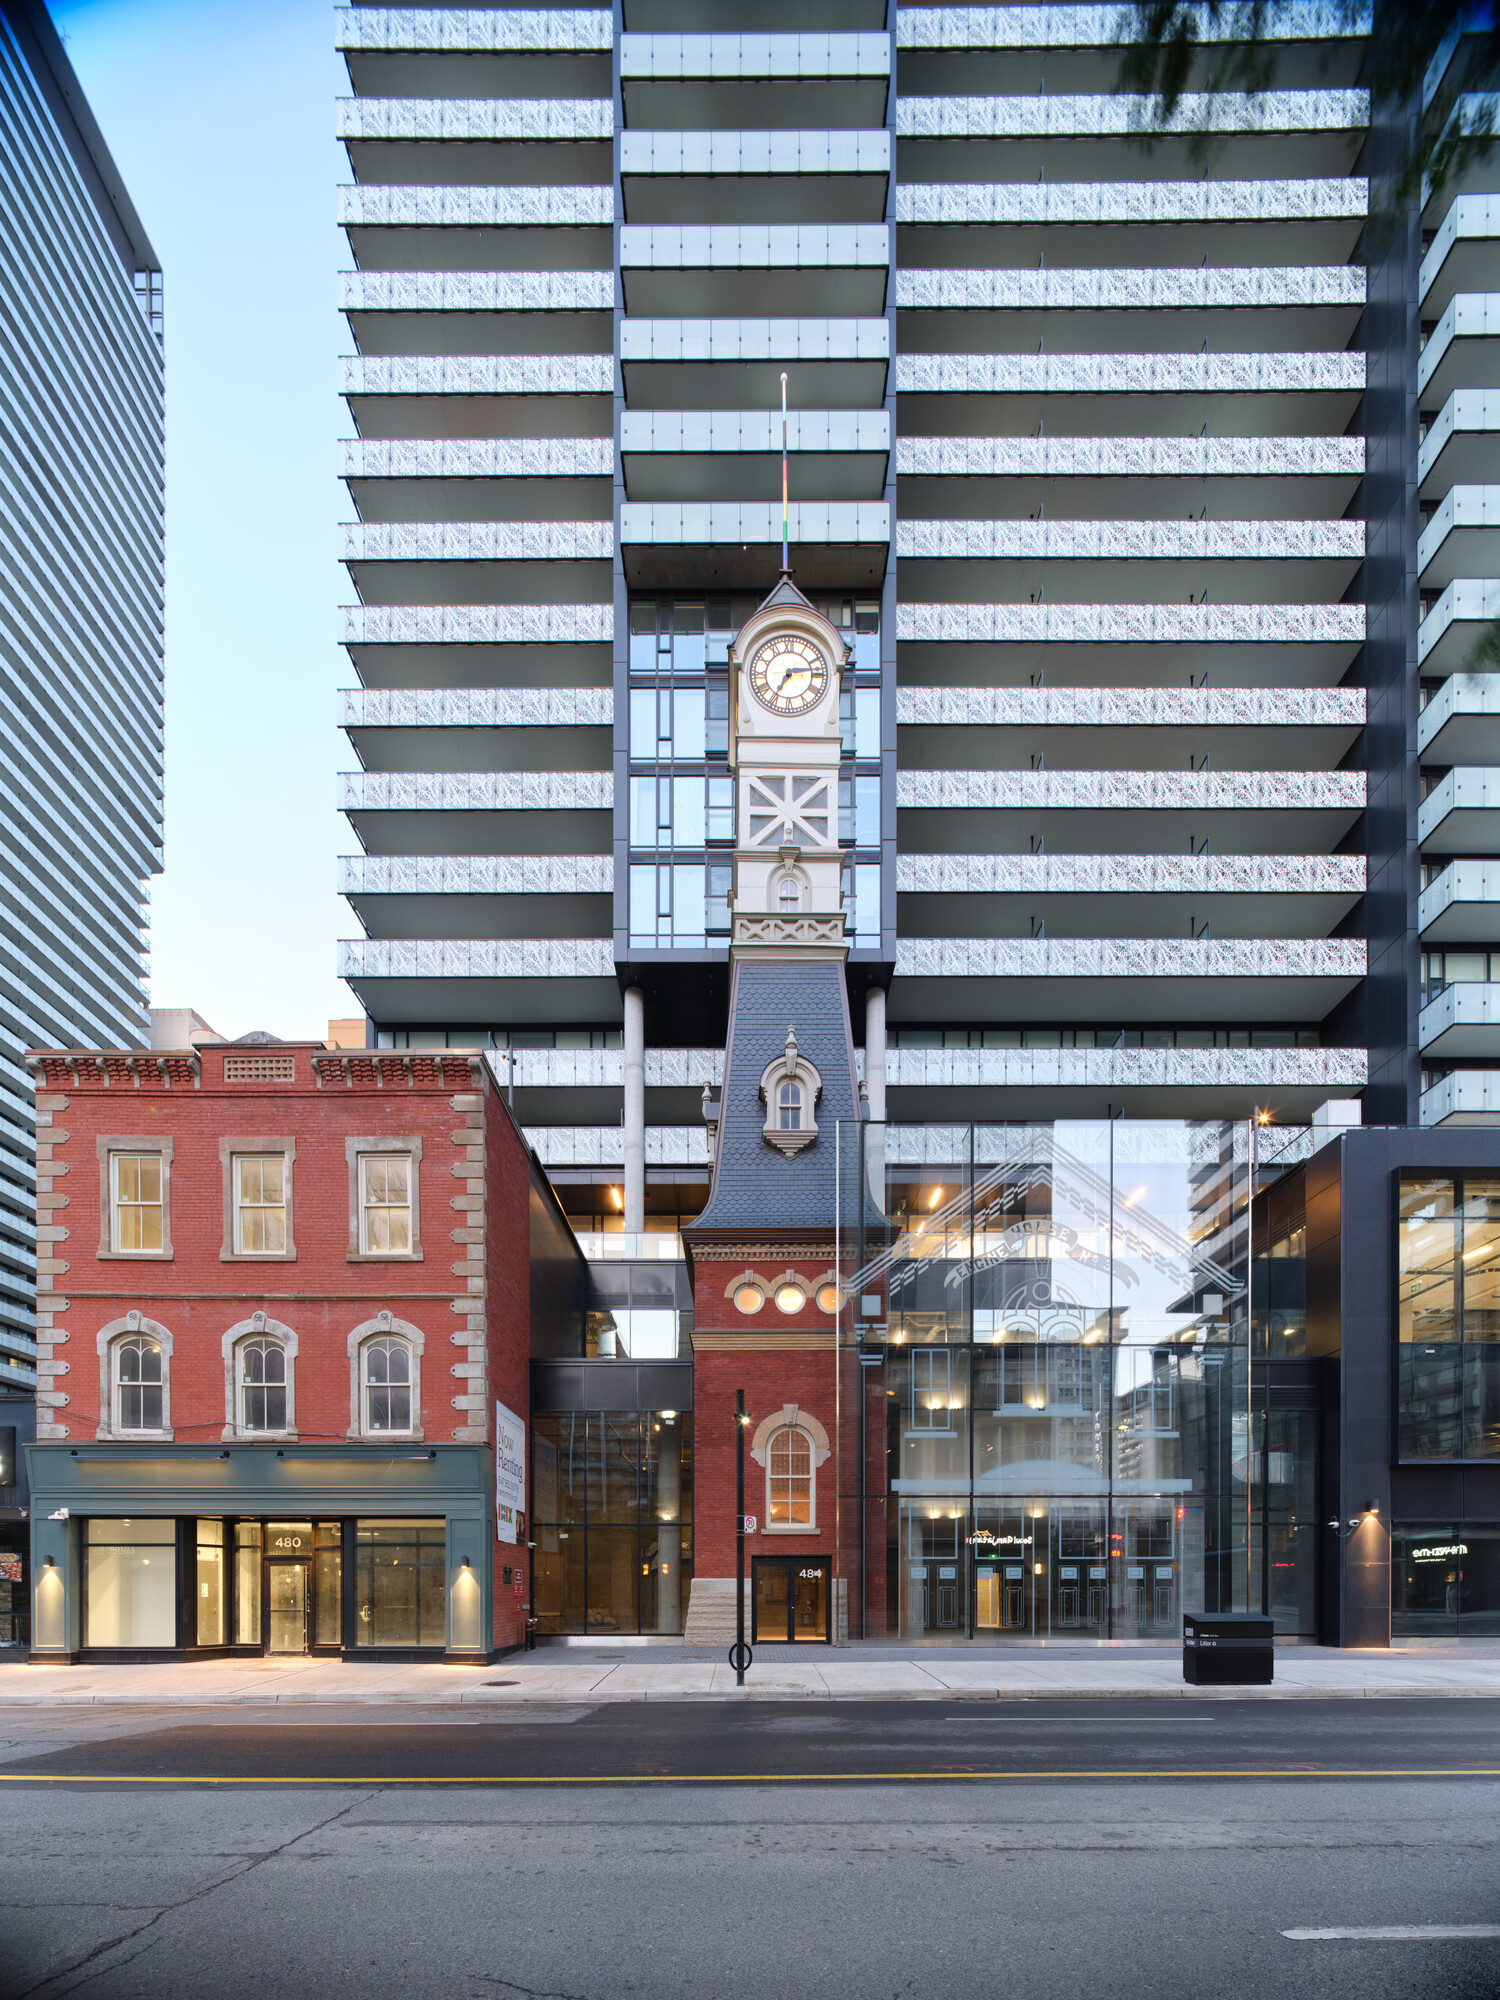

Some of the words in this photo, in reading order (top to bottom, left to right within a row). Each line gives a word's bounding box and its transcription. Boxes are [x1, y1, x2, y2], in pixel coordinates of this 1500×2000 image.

[1010, 1220, 1068, 1241] HOUSE
[498, 1423, 514, 1452] Now
[498, 1446, 523, 1484] Renting
[275, 1537, 301, 1547] 480
